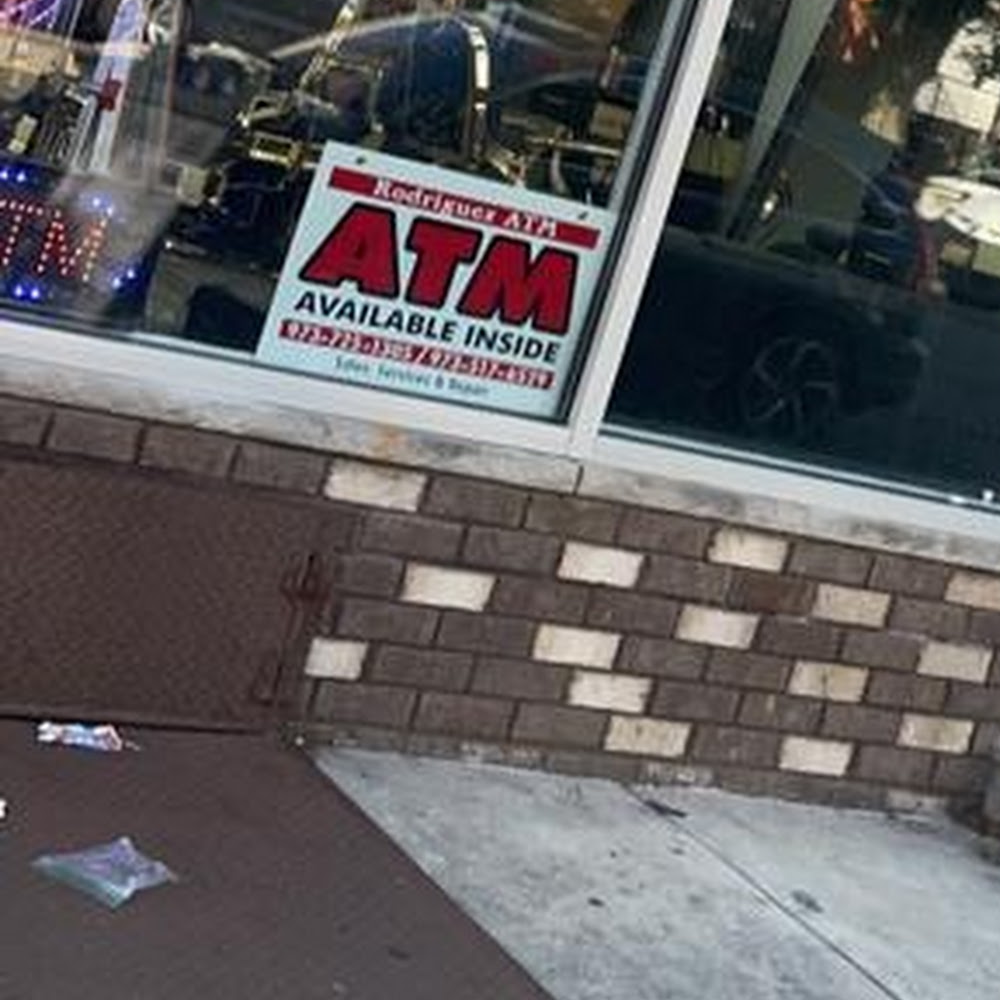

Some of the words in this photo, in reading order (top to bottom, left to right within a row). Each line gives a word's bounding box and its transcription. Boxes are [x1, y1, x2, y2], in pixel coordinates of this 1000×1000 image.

[373, 180, 496, 223] Rodriguez
[503, 209, 558, 238] ATM
[299, 202, 579, 337] ATM
[295, 290, 457, 342] AVAILABLE
[464, 324, 561, 364] INSIDE
